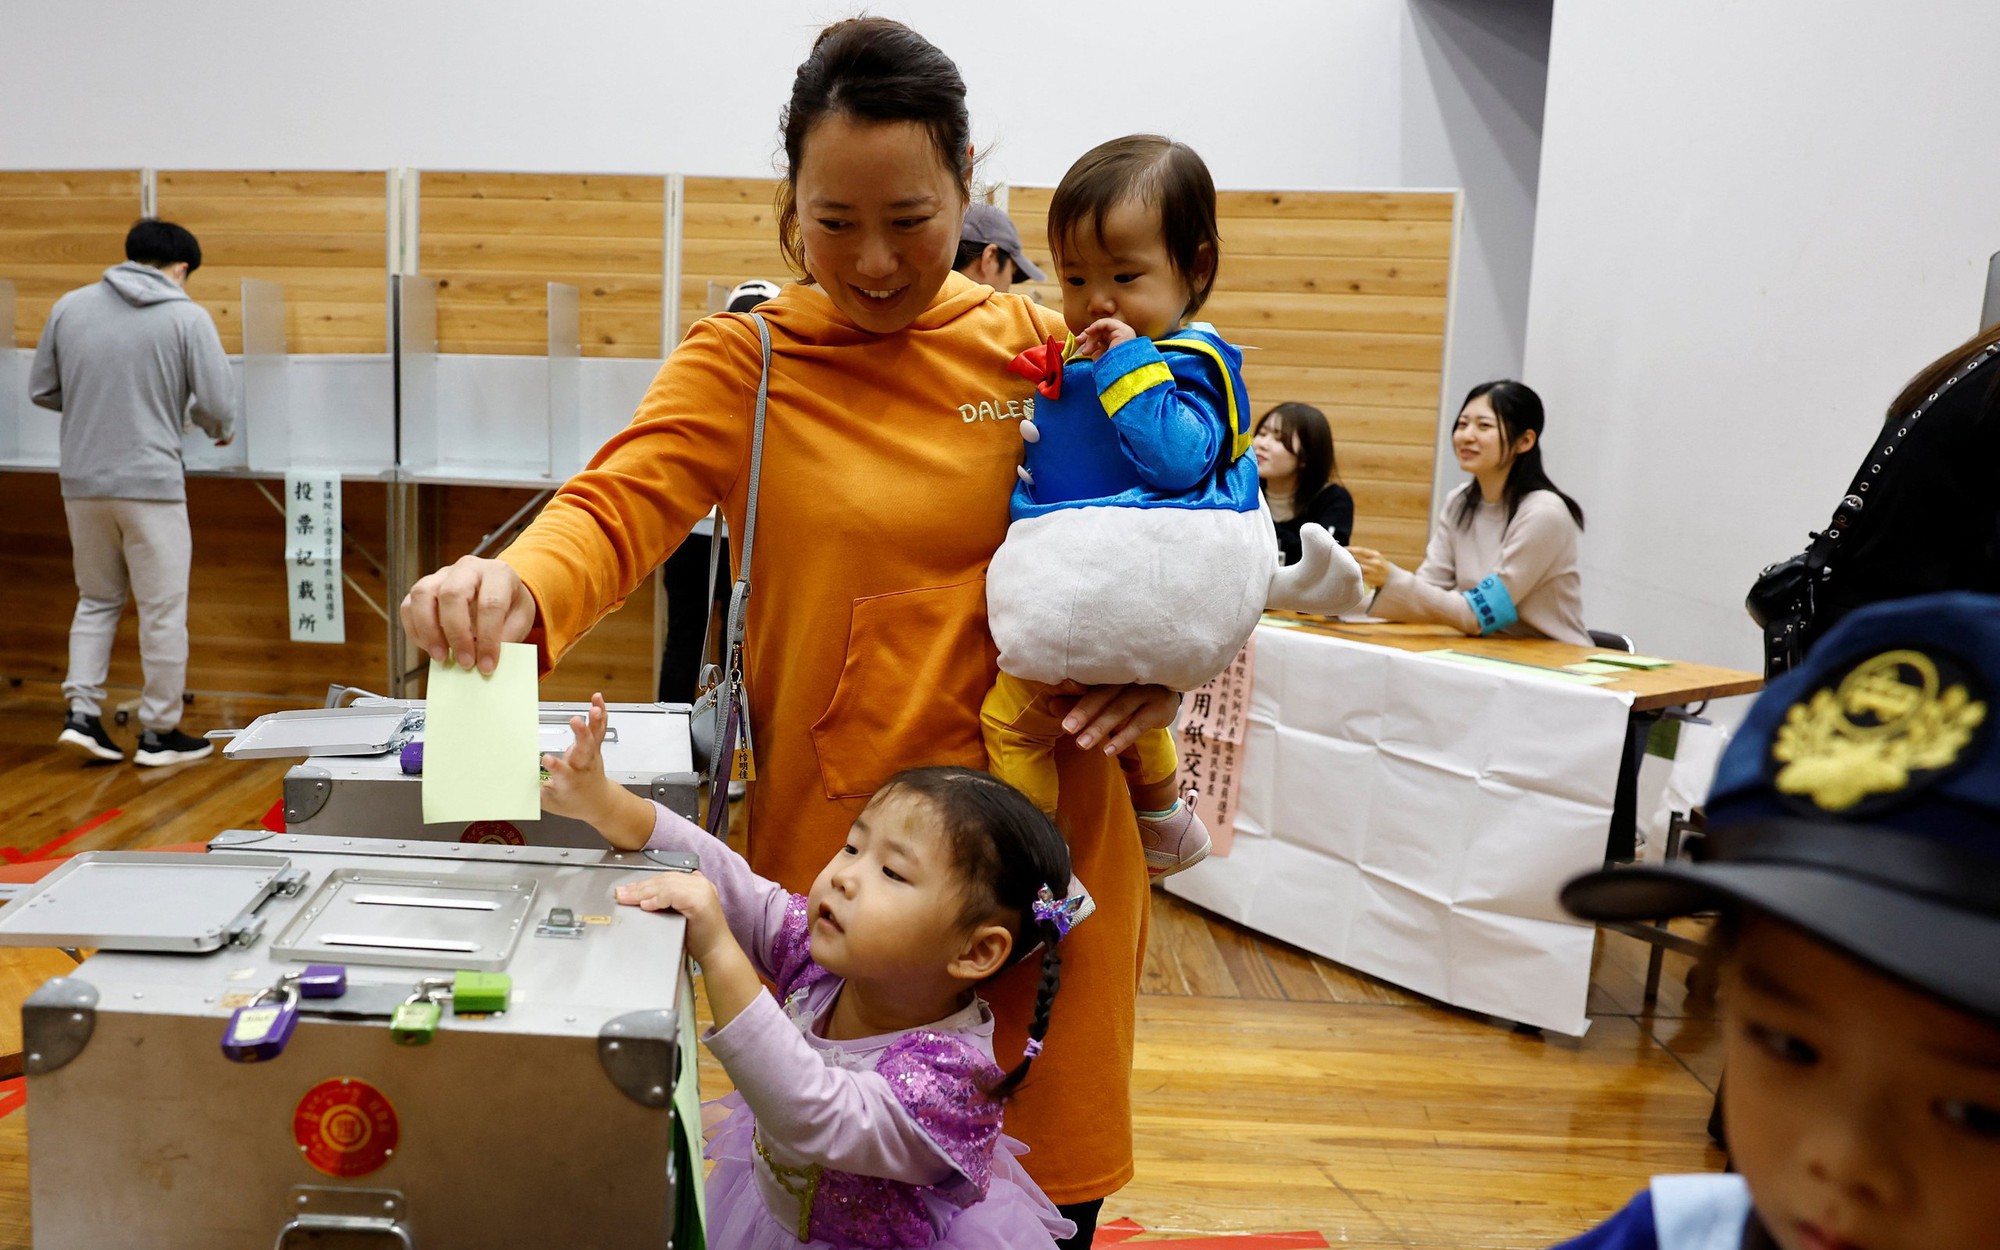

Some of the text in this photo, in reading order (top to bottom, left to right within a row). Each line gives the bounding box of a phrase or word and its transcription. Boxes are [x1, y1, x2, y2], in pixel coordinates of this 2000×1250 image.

[958, 400, 1023, 423] DALE
[294, 481, 316, 633] 投票記載所
